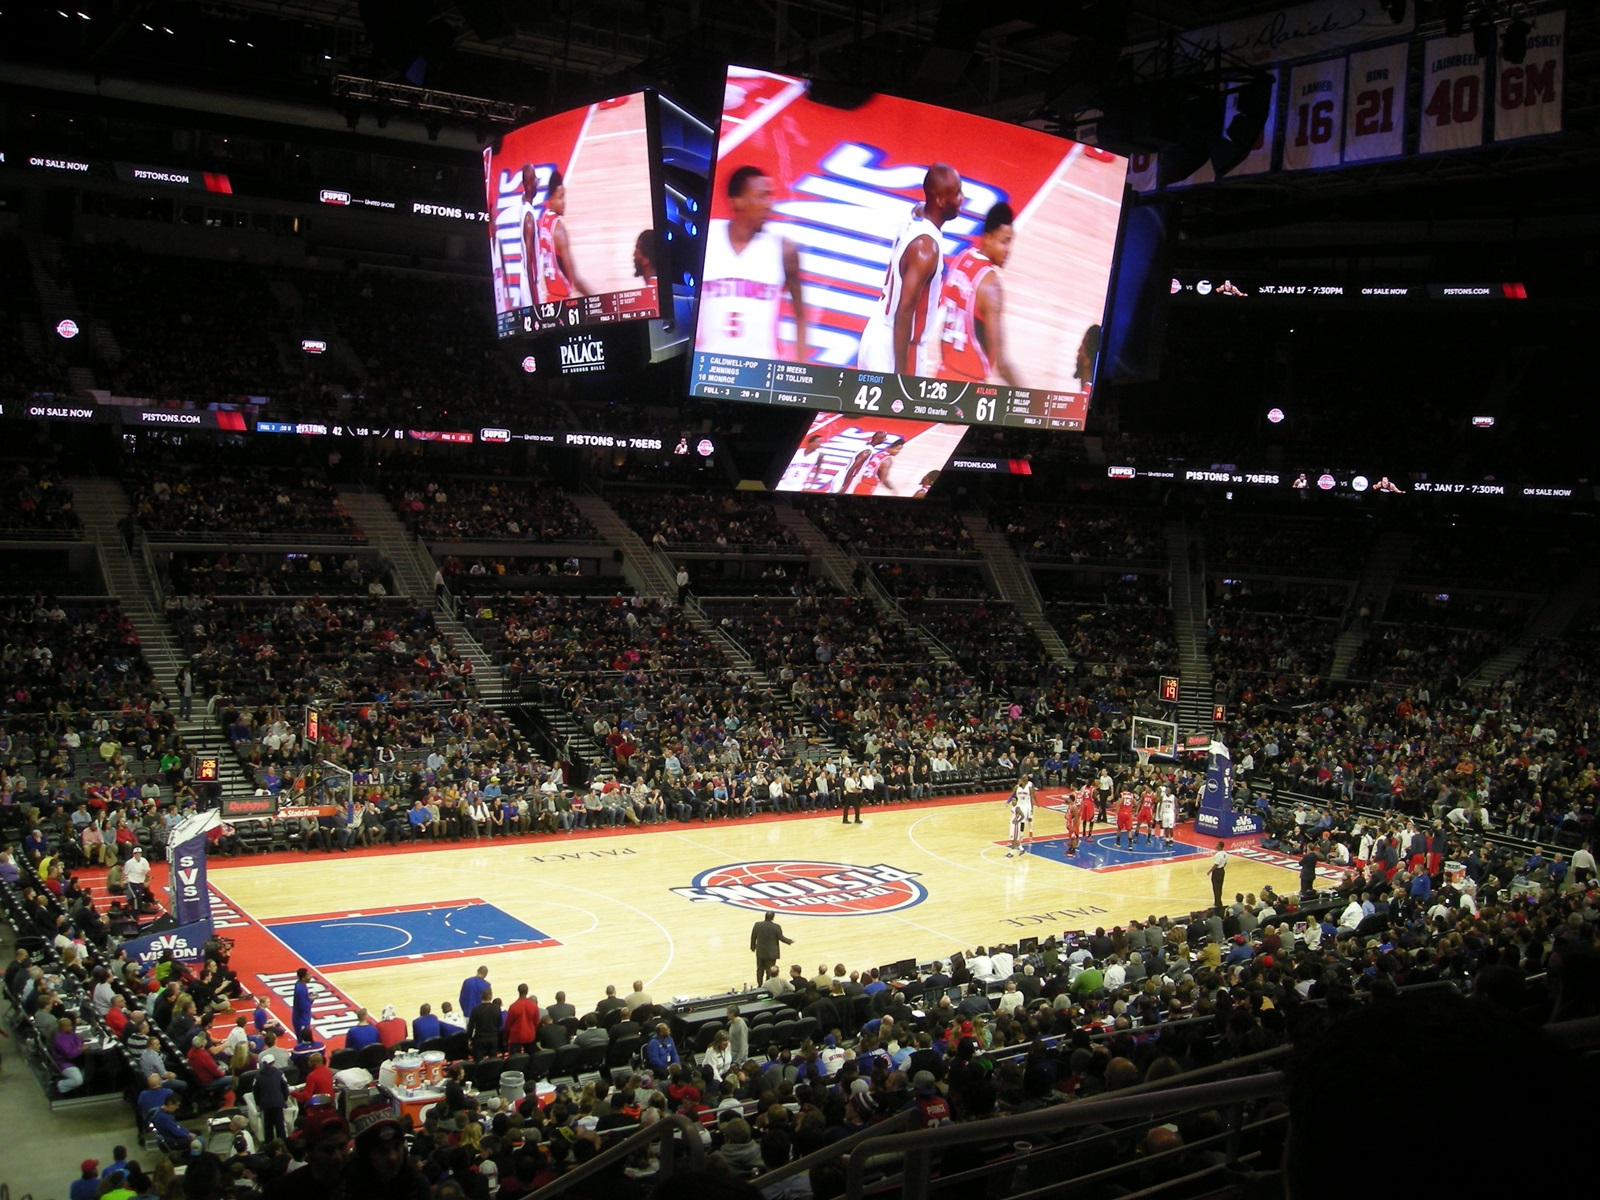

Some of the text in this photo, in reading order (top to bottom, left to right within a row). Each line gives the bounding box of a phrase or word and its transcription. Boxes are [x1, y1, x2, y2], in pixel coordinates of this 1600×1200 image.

[1366, 69, 1389, 82] BING
[1500, 59, 1557, 110] GM
[1424, 75, 1479, 126] 40
[1355, 87, 1394, 136] 21
[1294, 99, 1333, 147] 16
[30, 157, 89, 172] ON SALE NOW
[134, 169, 190, 184] PISTONS.COM
[413, 203, 463, 219] PISTONS
[1277, 286, 1295, 294] JAN
[1296, 286, 1307, 294] 17
[1313, 286, 1343, 295] 7:30PM
[540, 303, 556, 318] 1:26
[568, 308, 580, 326] 61
[523, 316, 533, 332] 42
[560, 341, 605, 365] PALACE
[710, 357, 759, 370] CALDWELL-POP
[767, 363, 772, 371] 2
[777, 364, 785, 373] 20
[786, 366, 807, 375] MEEKS
[709, 366, 740, 376] JENNINGS
[707, 374, 735, 384] MONROE
[785, 375, 814, 385] TOLLIVER
[858, 374, 885, 384] DETROIT
[703, 386, 719, 395] FULL
[919, 380, 948, 401] 1:26
[975, 387, 998, 396] ATLANTA
[778, 394, 798, 403] FOULS
[854, 385, 883, 411] 42
[30, 407, 93, 418] ON SALE NOW
[913, 405, 948, 416] 2ND Quarter
[975, 397, 997, 422] 61
[142, 412, 201, 423] PISTONS.COM
[332, 426, 343, 436] 42
[394, 430, 404, 439] 61
[483, 430, 508, 439] SUPER
[566, 434, 662, 450] PISTONS vs 76ERS
[953, 461, 998, 470] PISTONS.COM
[1185, 471, 1230, 482] PISTONS
[1245, 474, 1280, 485] 76ERS
[1414, 482, 1504, 495] SAT, JAN 17 7:30PM
[1535, 488, 1552, 496] SALE
[1166, 687, 1176, 698] 19
[1199, 813, 1219, 825] DMC
[1231, 824, 1257, 833] VISION
[669, 863, 923, 902] PISTONS
[772, 886, 896, 908] DETROIT
[999, 905, 1108, 928] PALACE
